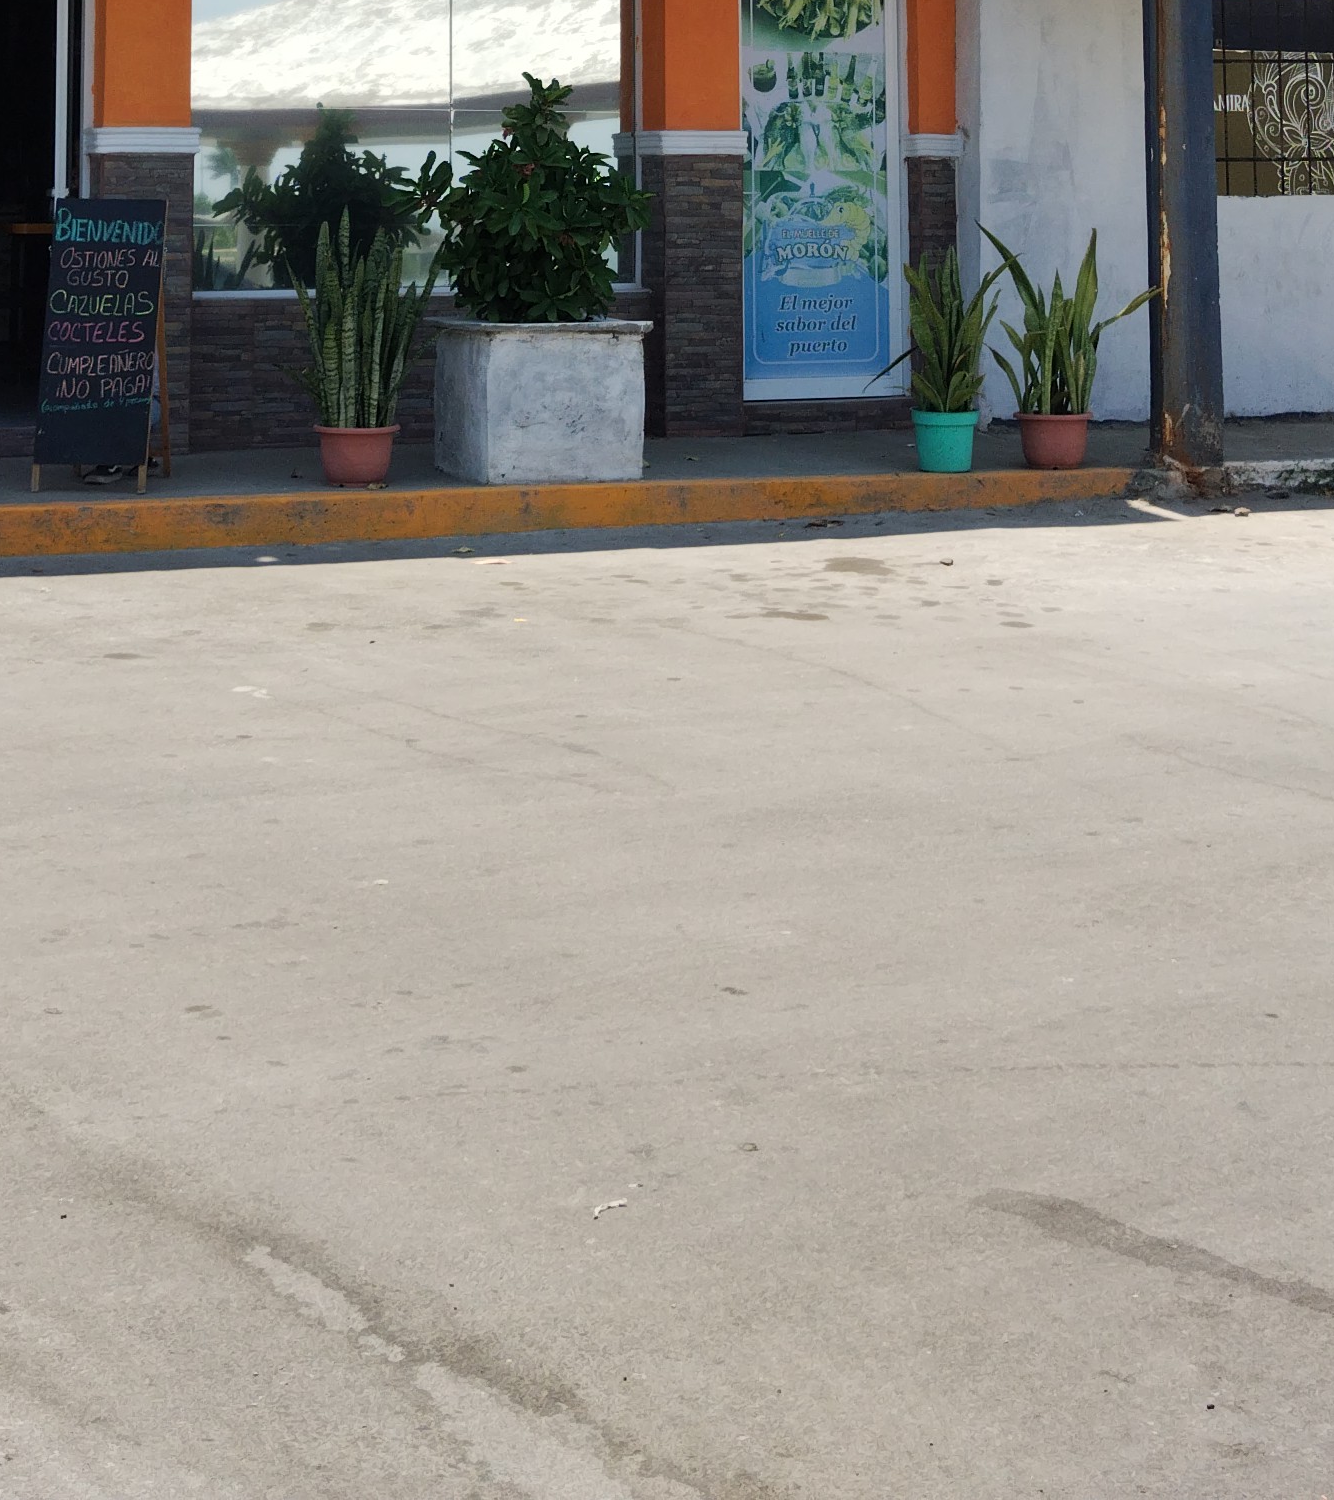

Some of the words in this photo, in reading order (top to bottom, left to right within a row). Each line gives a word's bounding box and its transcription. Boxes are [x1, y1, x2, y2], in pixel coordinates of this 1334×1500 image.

[60, 247, 136, 269] OSTIONES
[142, 250, 161, 267] AL
[777, 240, 848, 262] MORÓN
[67, 268, 129, 288] GUSTO
[49, 289, 155, 316] CAZUELAS
[779, 294, 798, 311] El
[802, 294, 853, 313] mejor
[48, 321, 145, 344] COCTELES
[775, 315, 827, 332] sabor
[830, 312, 857, 331] del
[789, 339, 848, 357] puerto
[47, 349, 155, 377] CUMPLEAÑERO
